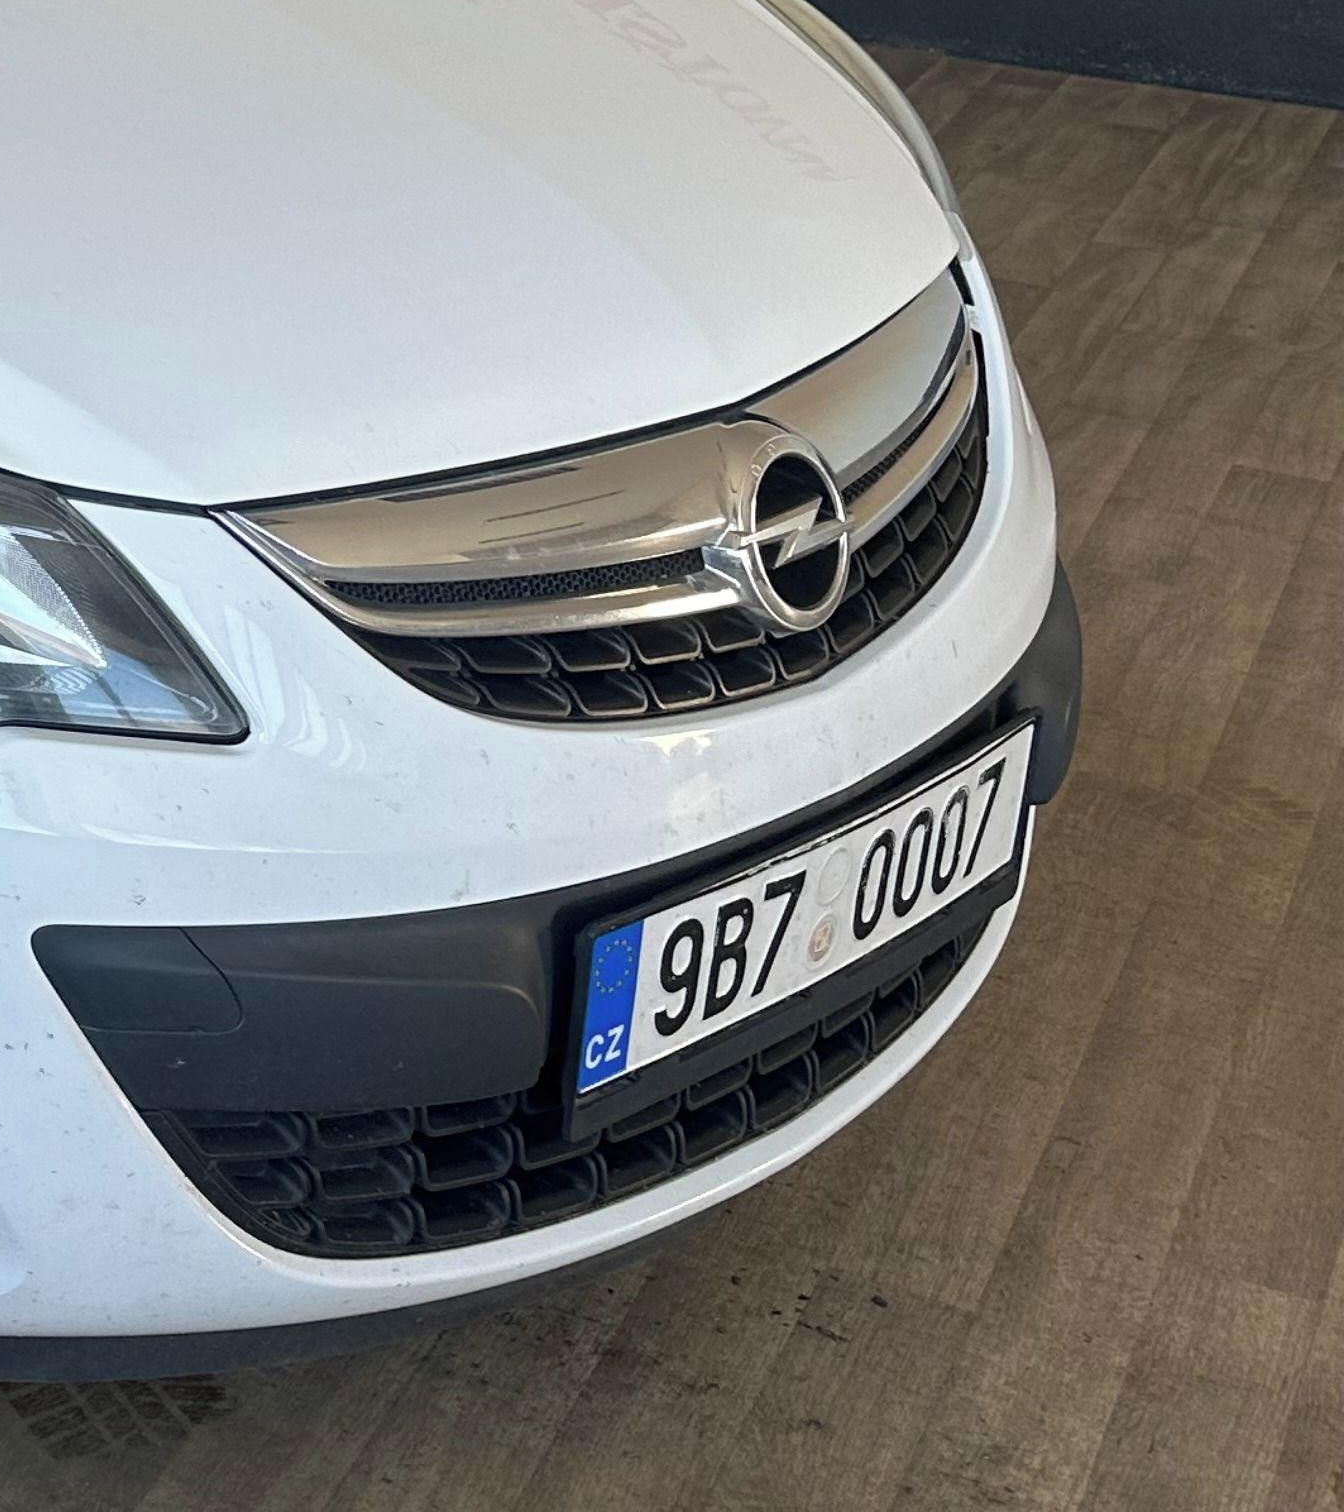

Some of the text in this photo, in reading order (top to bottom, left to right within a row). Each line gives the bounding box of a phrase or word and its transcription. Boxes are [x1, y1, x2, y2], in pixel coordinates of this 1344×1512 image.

[653, 756, 1008, 1038] 9B7 0007
[584, 1023, 626, 1071] CZ
